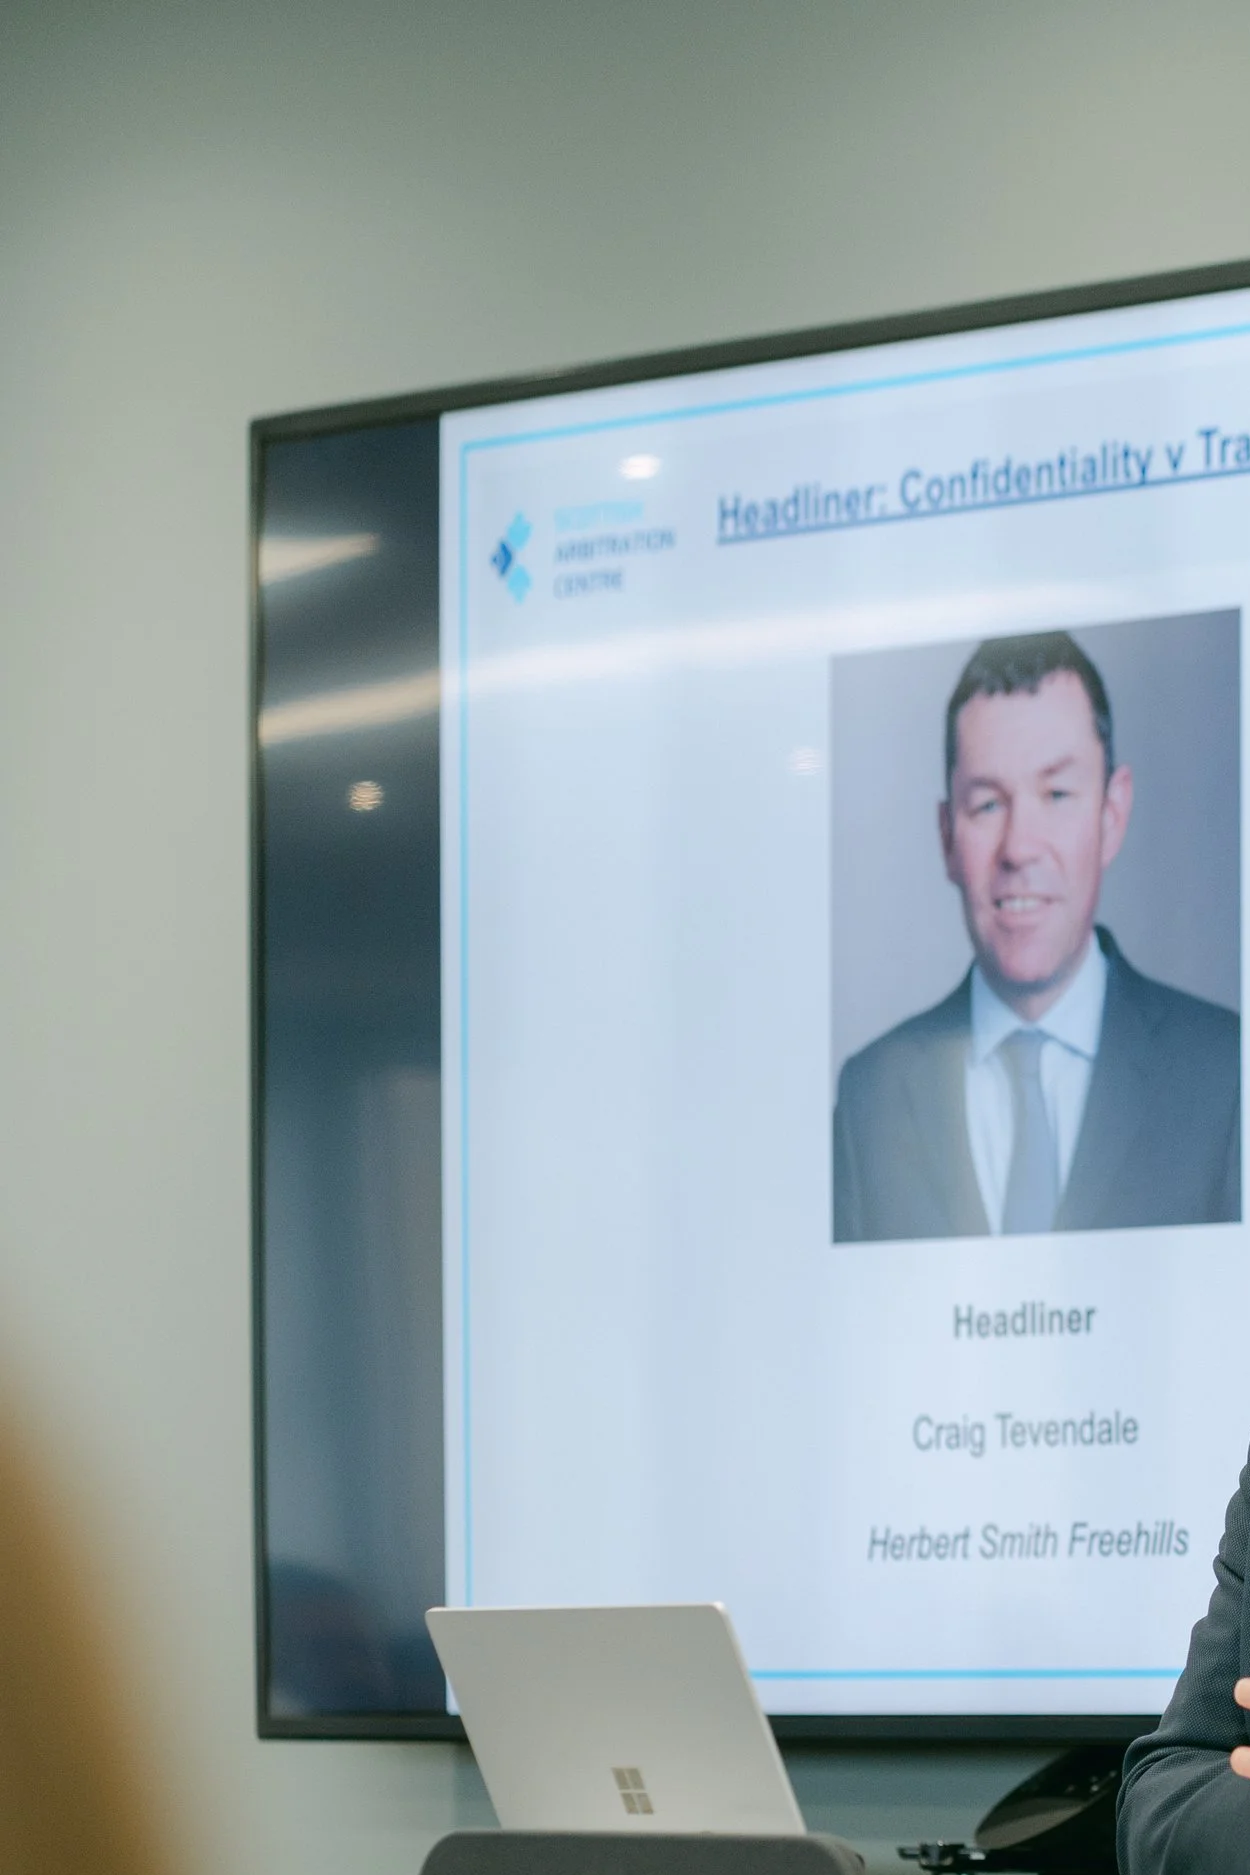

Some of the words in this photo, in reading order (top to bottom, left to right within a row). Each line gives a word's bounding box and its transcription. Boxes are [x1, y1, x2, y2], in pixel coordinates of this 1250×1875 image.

[717, 481, 887, 534] Headliner:
[899, 440, 1153, 510] Confidentiality
[1165, 442, 1186, 471] v
[952, 1301, 1097, 1339] Headliner
[912, 1414, 987, 1459] Craig
[994, 1409, 1140, 1449] Tevendale
[867, 1525, 970, 1562] Herbert
[979, 1522, 1059, 1560] Smith
[1067, 1520, 1190, 1558] Freehills
